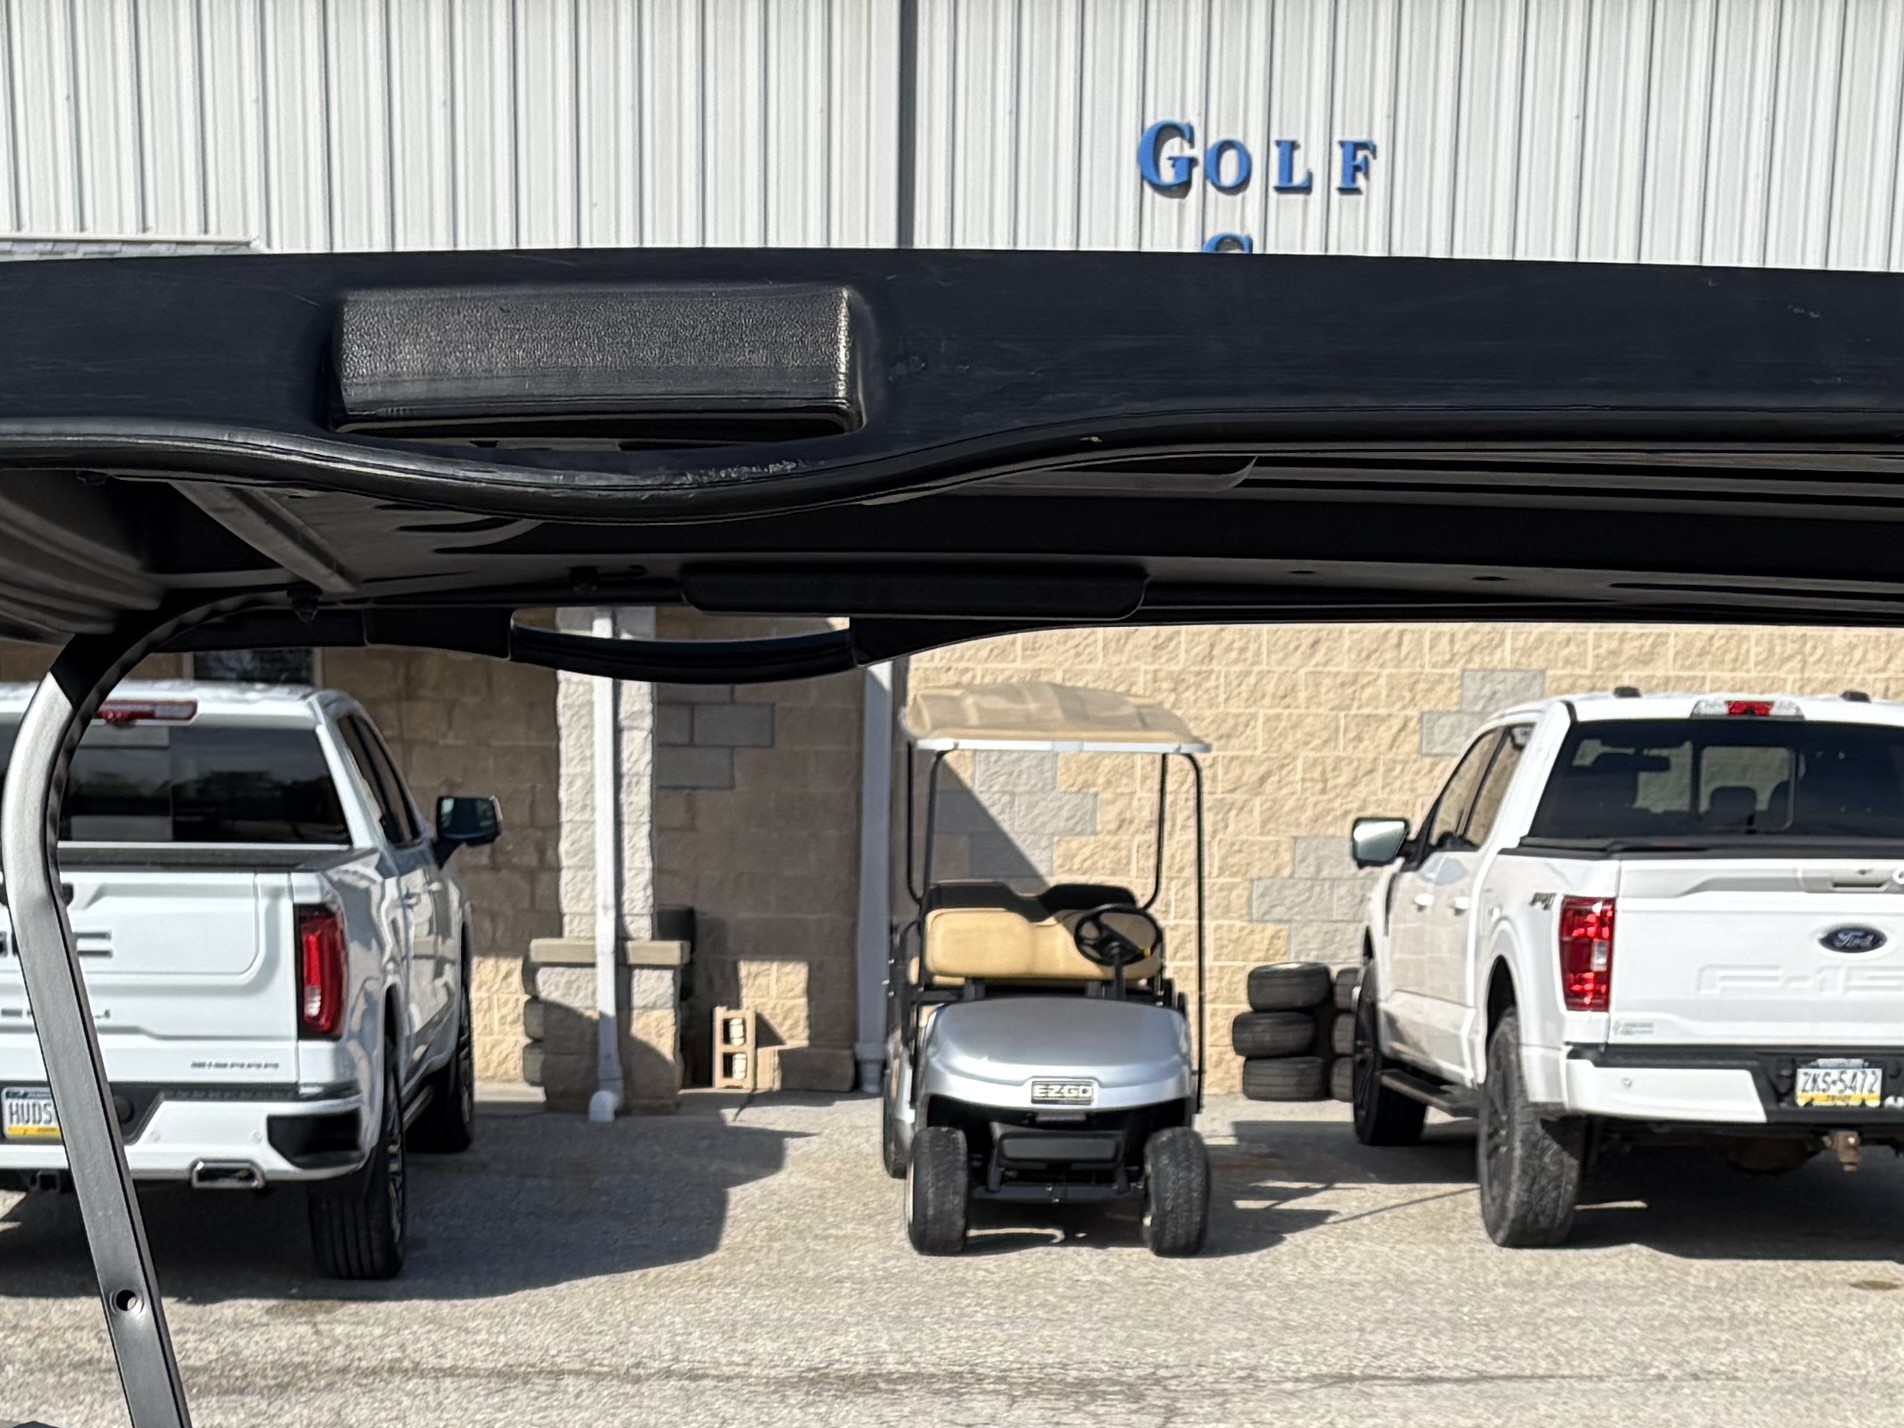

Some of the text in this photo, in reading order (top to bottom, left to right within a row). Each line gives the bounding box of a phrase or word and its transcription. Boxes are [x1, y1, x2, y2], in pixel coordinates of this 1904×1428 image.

[1137, 120, 1377, 197] GOLF
[1834, 931, 1874, 948] Ford
[8, 1101, 53, 1125] HUDS
